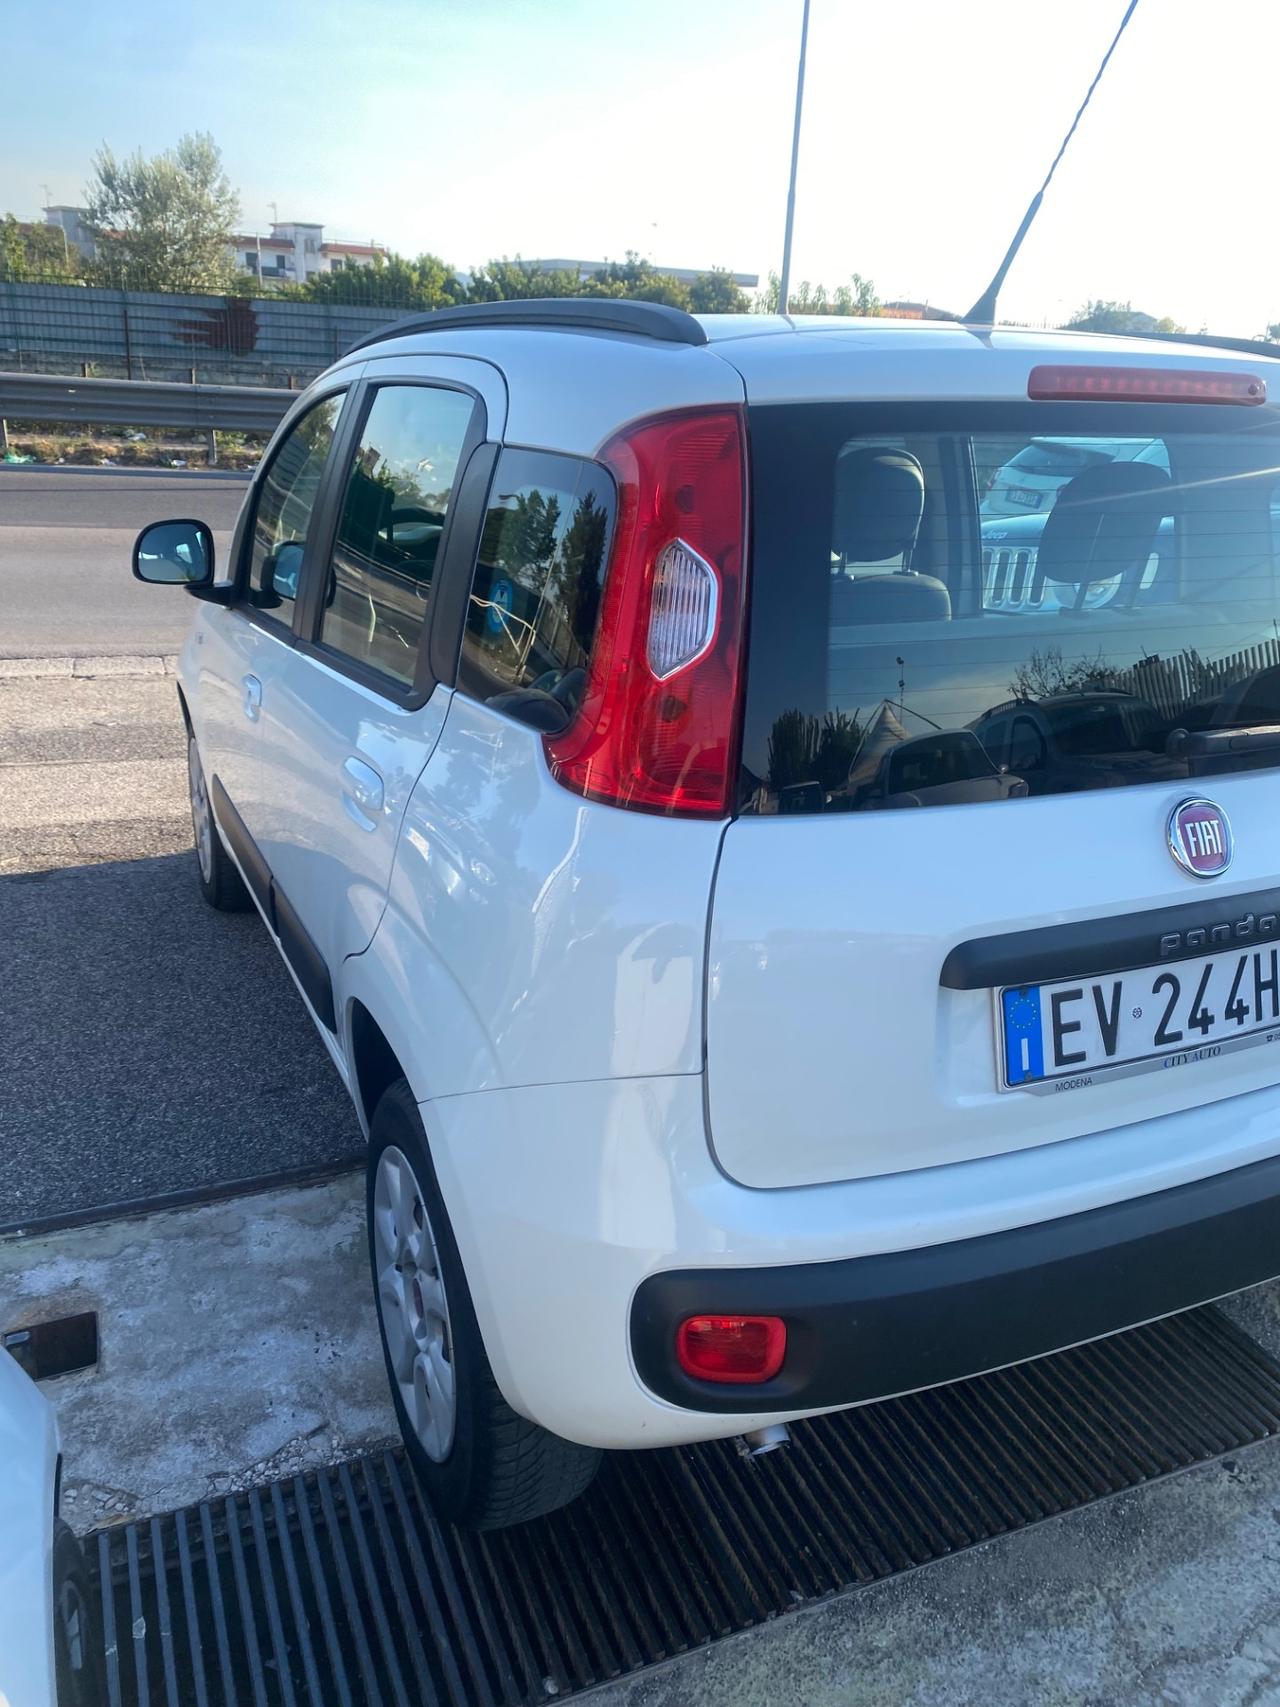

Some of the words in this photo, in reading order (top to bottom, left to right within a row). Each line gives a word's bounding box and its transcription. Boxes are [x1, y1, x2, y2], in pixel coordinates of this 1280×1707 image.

[1185, 820, 1223, 857] FIAT
[1159, 912, 1278, 956] panda
[1050, 981, 1123, 1068] EV
[1151, 948, 1280, 1046] 244H
[1163, 1054, 1189, 1069] CITY
[1191, 1046, 1221, 1064] AUTO
[1055, 1077, 1093, 1092] MODENA
